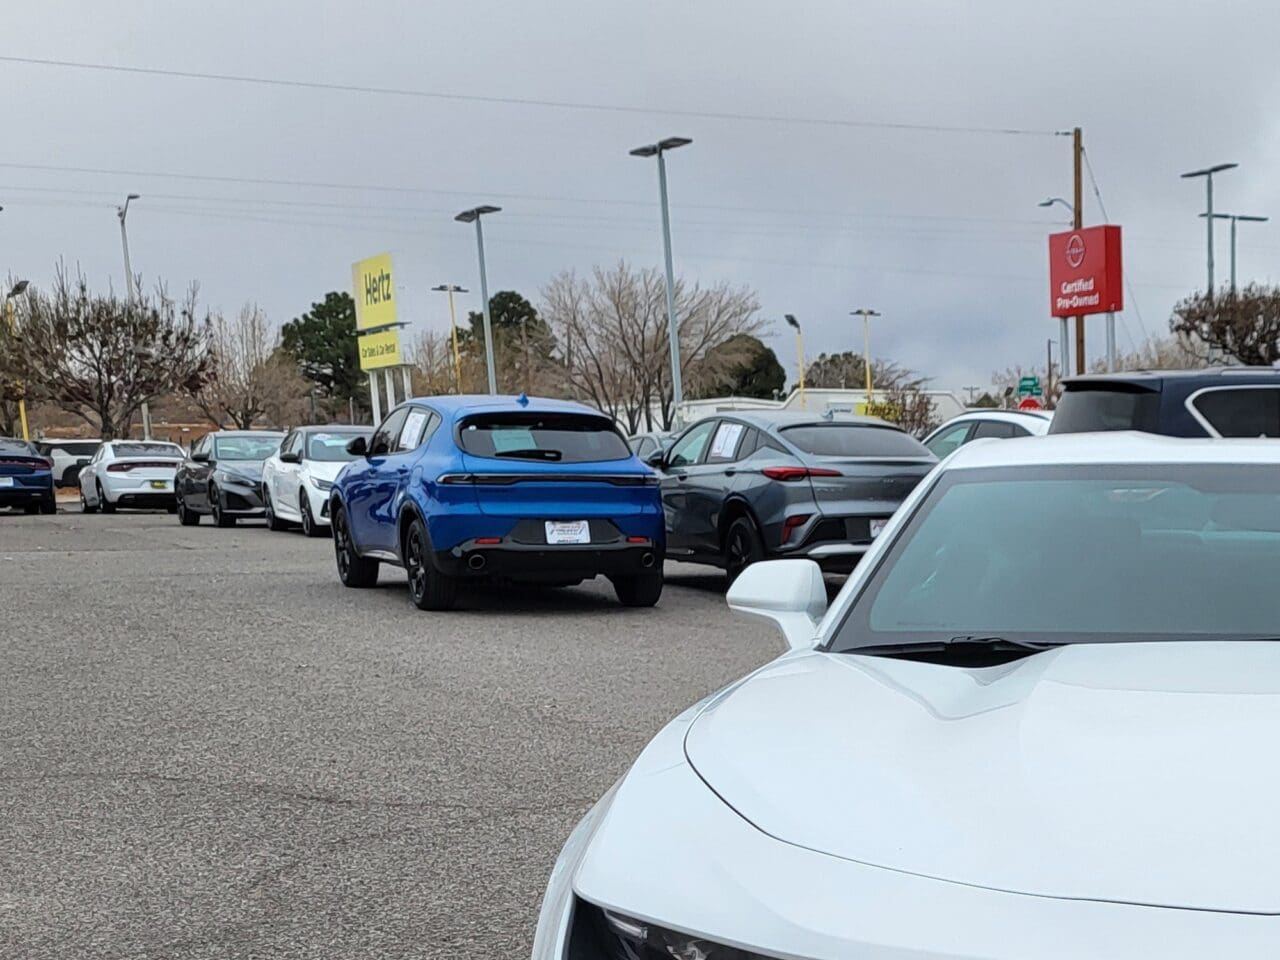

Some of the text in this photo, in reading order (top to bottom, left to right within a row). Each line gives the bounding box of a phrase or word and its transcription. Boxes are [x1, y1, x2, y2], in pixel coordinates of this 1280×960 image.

[364, 268, 392, 306] Hertz
[1061, 277, 1095, 295] Certified
[1056, 292, 1100, 310] Pre-Owned
